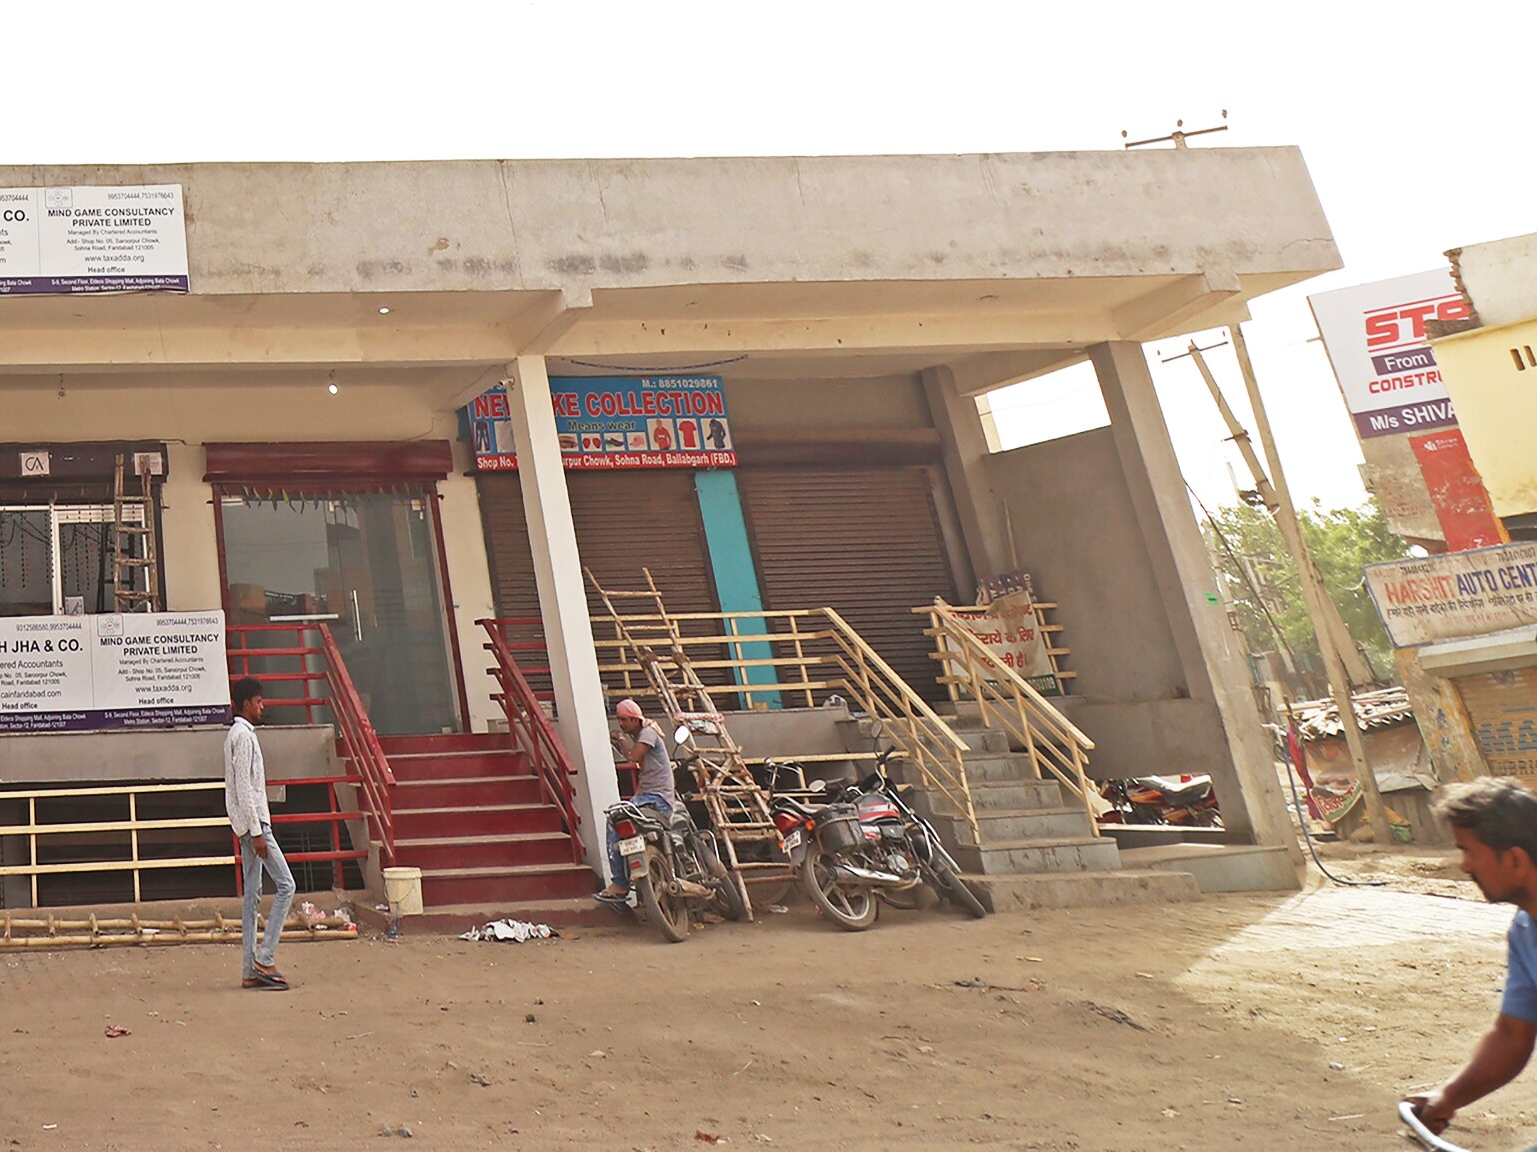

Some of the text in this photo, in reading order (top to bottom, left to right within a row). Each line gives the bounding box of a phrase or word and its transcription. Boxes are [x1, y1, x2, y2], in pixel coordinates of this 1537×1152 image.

[3, 210, 30, 222] CO.
[48, 208, 175, 217] MIND GAME CONSULTANCY
[72, 218, 151, 227] PRIVATE LIMITED
[1385, 354, 1429, 371] From
[585, 392, 725, 417] COLLECTION
[568, 422, 637, 432] Means wear
[1369, 415, 1399, 431] M/s
[477, 457, 498, 469] Shop
[499, 457, 514, 467] No.
[583, 454, 613, 468] Chowk,
[615, 454, 639, 466] Sohna
[641, 454, 665, 466] Road,
[711, 452, 736, 466] (FBD.)
[1456, 569, 1498, 596] AUTO
[12, 640, 41, 654] JHA
[58, 638, 83, 652] CO.
[101, 634, 219, 646] MIND GAME CONSULTANCY
[123, 646, 198, 656] PRIVATE LIMITED
[17, 660, 63, 669] Accountants
